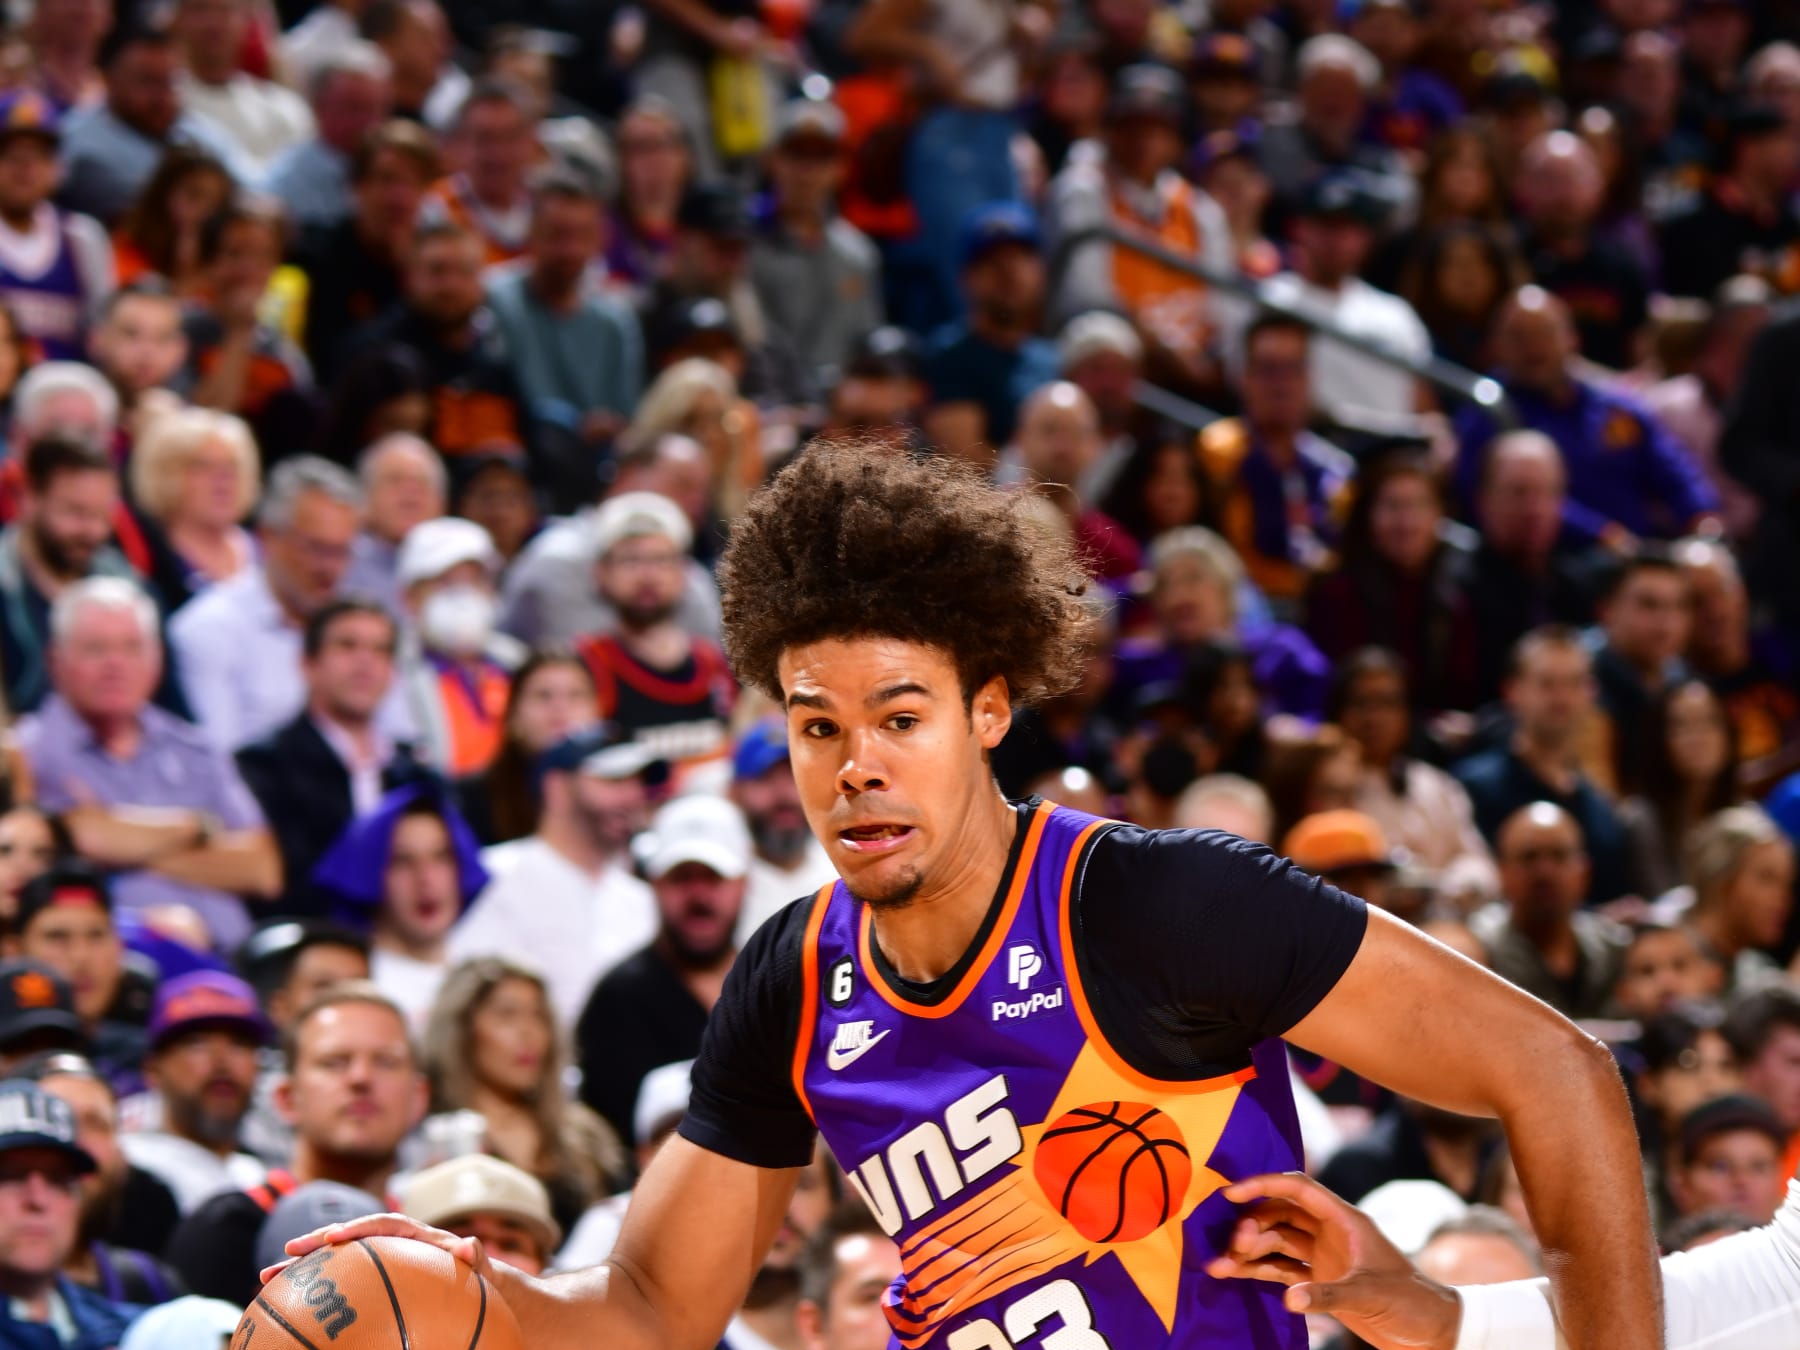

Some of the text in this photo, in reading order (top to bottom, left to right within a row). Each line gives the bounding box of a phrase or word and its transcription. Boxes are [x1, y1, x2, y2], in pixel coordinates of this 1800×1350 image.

[832, 962, 852, 1002] 6
[992, 987, 1063, 1021] PayPal
[835, 1020, 875, 1050] NIKE
[847, 1073, 1024, 1238] UNS
